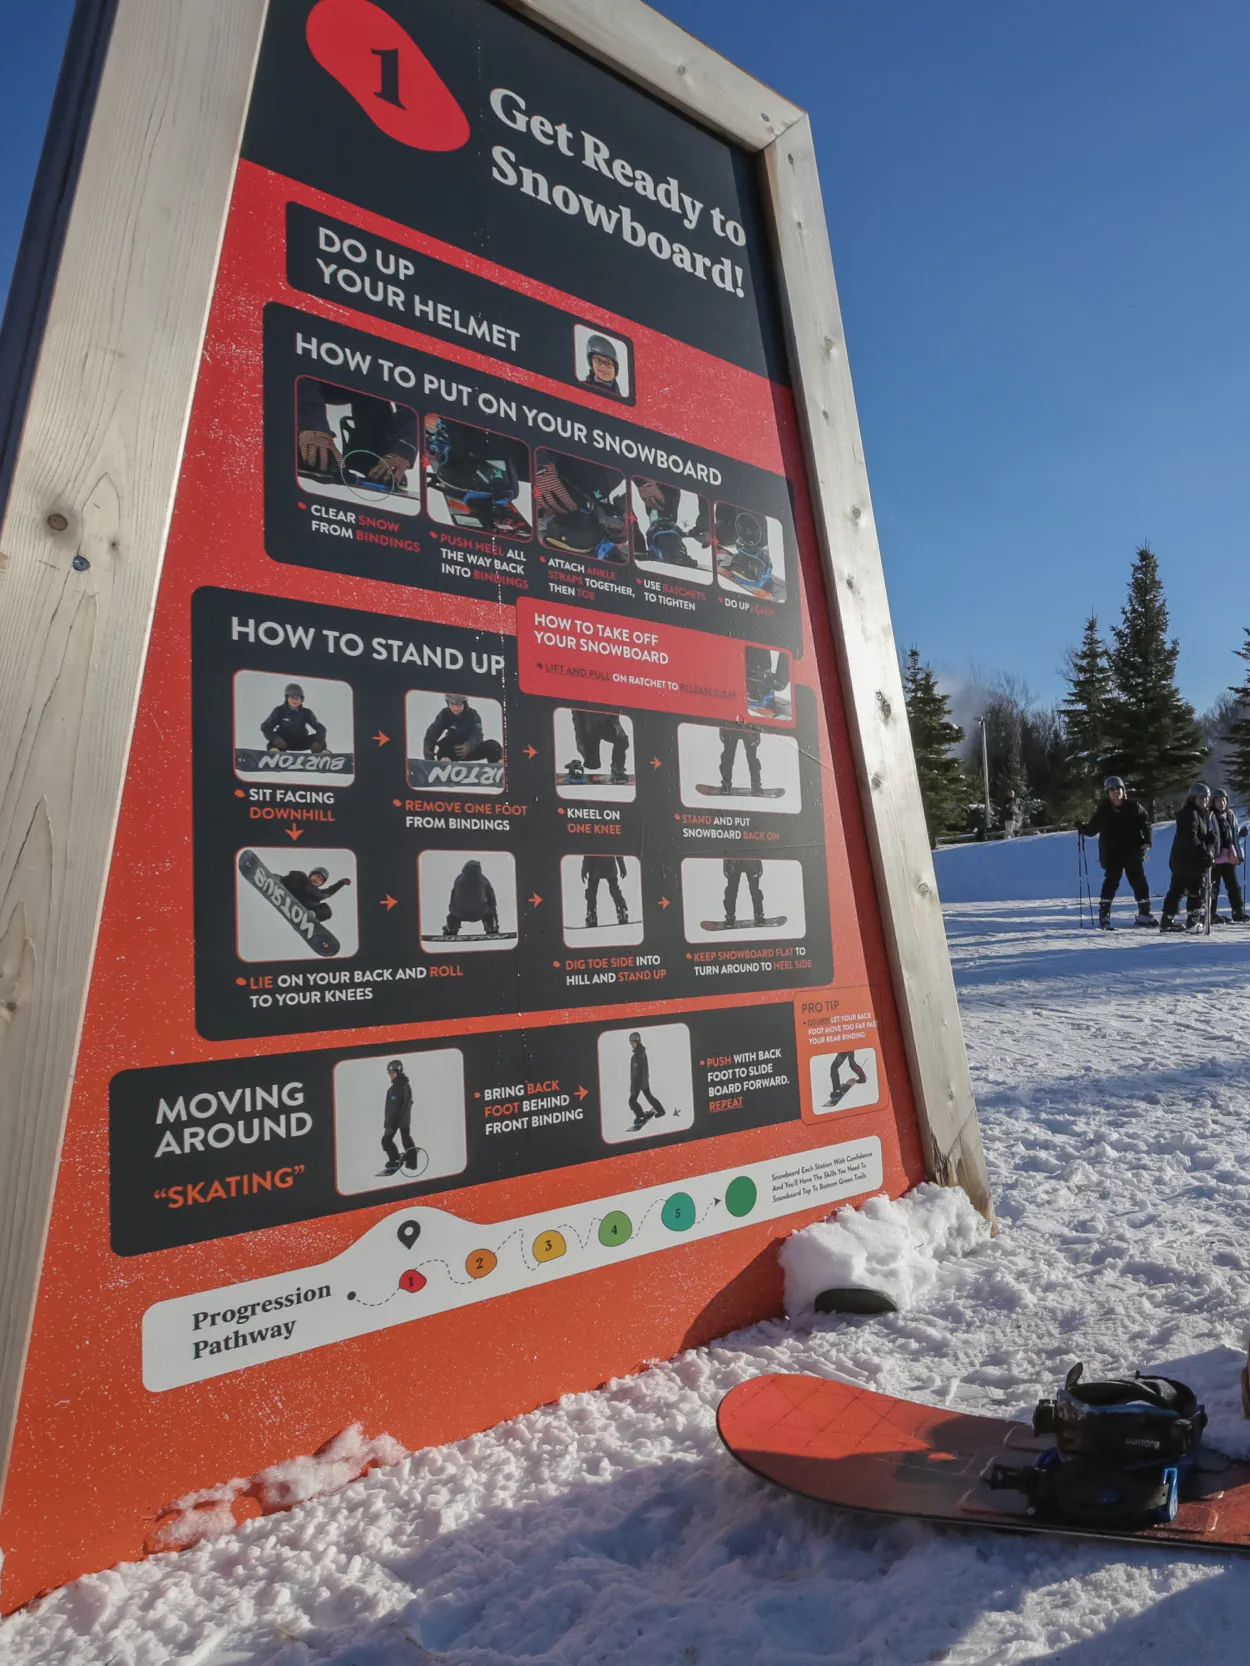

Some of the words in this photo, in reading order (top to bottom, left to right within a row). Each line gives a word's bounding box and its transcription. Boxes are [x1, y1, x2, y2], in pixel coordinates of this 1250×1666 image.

[371, 48, 407, 110] 1
[490, 88, 575, 157] Get
[582, 131, 703, 231] Ready
[711, 207, 747, 248] to
[491, 145, 746, 298] Snowboard!
[319, 227, 367, 263] DO
[376, 249, 416, 281] UP
[316, 258, 406, 312] YOUR
[414, 300, 521, 352] HELMET
[295, 332, 372, 374] HOW
[378, 361, 415, 389] TO
[424, 374, 472, 406] PUT
[478, 393, 516, 420] ON
[522, 405, 588, 443] YOUR
[592, 430, 722, 486] SNOWBOARD
[311, 505, 356, 524] CLEAR
[358, 515, 399, 532] SNOW
[312, 520, 353, 539] FROM
[356, 530, 420, 552] BINDINGS
[440, 534, 472, 549] PUSH
[476, 540, 504, 556] HEEL
[507, 549, 526, 561] ALL
[441, 548, 464, 562] THE
[467, 553, 492, 567] WAY
[495, 560, 524, 574] BACK
[548, 558, 584, 573] ATTACH
[587, 567, 616, 580] ANKLE
[442, 563, 471, 578] INTO
[473, 570, 528, 589] BINDINGS
[548, 570, 583, 584] STRAPS
[585, 578, 635, 598] TOGETHER,
[549, 583, 575, 596] THEN
[577, 589, 595, 600] TOE
[644, 580, 661, 591] USE
[663, 584, 705, 600] RATCHETS
[644, 592, 656, 602] TO
[658, 595, 695, 610] TIGHTEN
[725, 598, 737, 608] DO
[739, 601, 749, 610] UP
[534, 613, 571, 631] HOW
[574, 620, 593, 635] TO
[596, 624, 630, 642] TAKE
[632, 632, 658, 646] OFF
[231, 616, 315, 650] HOW
[322, 629, 364, 657] TO
[372, 638, 463, 670] STAND
[471, 652, 505, 676] UP
[534, 631, 576, 649] YOUR
[580, 639, 668, 664] SNOWBOARD
[546, 663, 564, 674] LIFT
[566, 666, 587, 677] AND
[589, 669, 610, 681] PULL
[613, 674, 627, 683] ON
[629, 676, 666, 689] RATCHET
[667, 681, 678, 690] TO
[680, 684, 712, 696] RELEASE
[258, 754, 346, 770] BURTON
[249, 789, 272, 801] SIT
[276, 789, 334, 804] FACING
[250, 807, 335, 821] DOWNHILL
[405, 800, 461, 813] REMOVE
[464, 802, 492, 814] ONE
[495, 804, 527, 816] FOOT
[567, 808, 601, 819] KNEEL
[604, 810, 620, 820] ON
[406, 816, 445, 828] FROM
[449, 818, 509, 830] BINDINGS
[567, 823, 591, 833] ONE
[594, 824, 621, 834] KNEE
[682, 814, 712, 824] STAND
[714, 816, 732, 826] AND
[735, 818, 750, 826] PUT
[683, 828, 741, 839] SNOWBOARD
[743, 831, 765, 840] BACK
[766, 832, 780, 840] ON
[566, 960, 585, 970] DIG
[588, 959, 608, 968] TOE
[611, 957, 633, 968] SIDE
[636, 955, 661, 966] INTO
[693, 952, 716, 962] KEEP
[718, 948, 774, 960] SNOWBOARD
[776, 947, 793, 957] FLAT
[795, 947, 806, 956] TO
[250, 976, 273, 989] LIE
[278, 974, 303, 988] ON
[307, 972, 350, 985] YOUR
[354, 969, 393, 983] BACK
[396, 967, 427, 980] AND
[429, 965, 464, 977] ROLL
[566, 974, 590, 986] HILL
[592, 973, 616, 984] AND
[618, 971, 650, 982] STAND
[653, 969, 667, 979] UP
[694, 965, 719, 976] TURN
[721, 963, 759, 974] AROUND
[761, 962, 772, 971] TO
[774, 960, 793, 970] HEEL
[795, 959, 812, 968] SIDE
[250, 995, 272, 1008] TO
[276, 991, 321, 1006] YOUR
[324, 988, 373, 1002] KNEES
[802, 1003, 822, 1013] PRO
[825, 1001, 839, 1012] TIP
[706, 1056, 731, 1068] PUSH
[733, 1052, 756, 1063] WITH
[758, 1048, 781, 1060] BACK
[708, 1070, 733, 1082] FOOT
[735, 1068, 747, 1078] TO
[749, 1063, 773, 1076] SLIDE
[484, 1085, 524, 1101] BRING
[527, 1080, 560, 1094] BACK
[709, 1083, 741, 1097] BOARD
[744, 1075, 789, 1091] FORWARD.
[155, 1081, 305, 1125] MOVING
[485, 1102, 520, 1118] FOOT
[523, 1095, 570, 1112] BEHIND
[709, 1096, 744, 1112] REPEAT
[485, 1118, 529, 1135] FRONT
[532, 1109, 583, 1127] BINDING
[154, 1112, 313, 1158] AROUND
[772, 1168, 800, 1181] Snowboard
[802, 1166, 813, 1174] Each
[815, 1162, 832, 1171] Station
[834, 1158, 845, 1166] With
[847, 1152, 872, 1162] Confidence
[800, 1176, 812, 1184] Have
[824, 1170, 836, 1178] Skills
[773, 1191, 801, 1202] Snowboard
[820, 1182, 838, 1190] Bottom
[839, 1177, 853, 1185] Green
[675, 1208, 681, 1219] 5
[610, 1224, 618, 1236] 4
[545, 1240, 552, 1252] 3
[476, 1258, 484, 1269] 2
[407, 1276, 414, 1287] 1
[192, 1283, 331, 1332] Progression
[193, 1319, 297, 1360] Pathway
